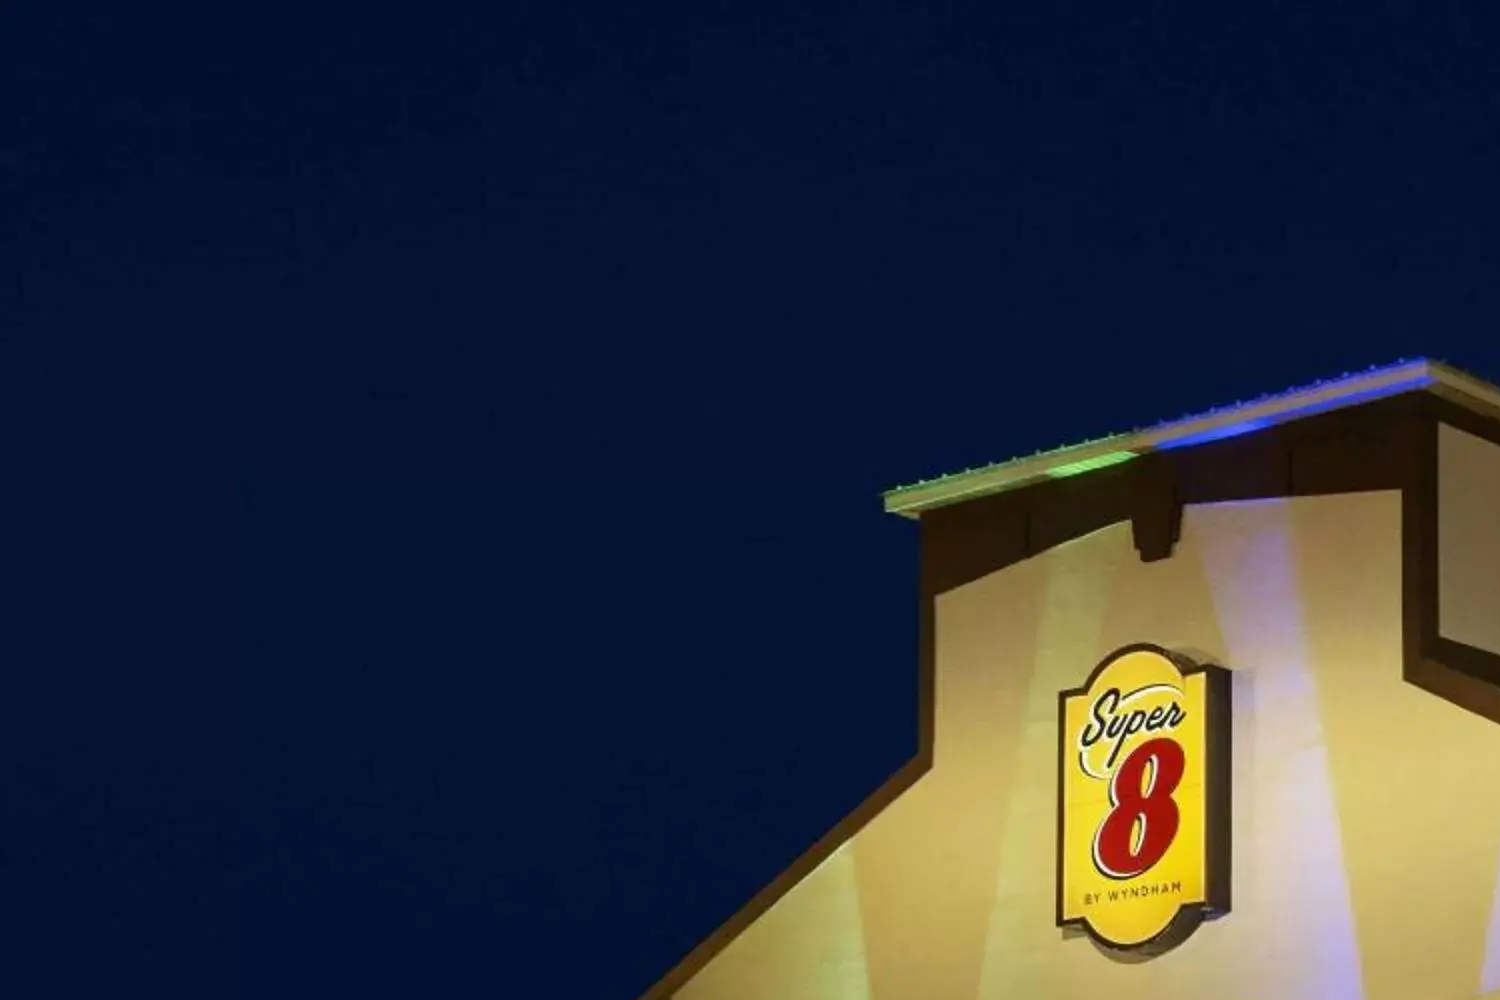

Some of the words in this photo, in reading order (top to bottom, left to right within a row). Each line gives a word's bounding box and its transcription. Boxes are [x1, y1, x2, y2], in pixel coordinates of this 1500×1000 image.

[1080, 687, 1187, 768] Super
[1092, 737, 1186, 881] 8
[1083, 890, 1100, 905] BY
[1107, 880, 1183, 903] WYNDHAM
